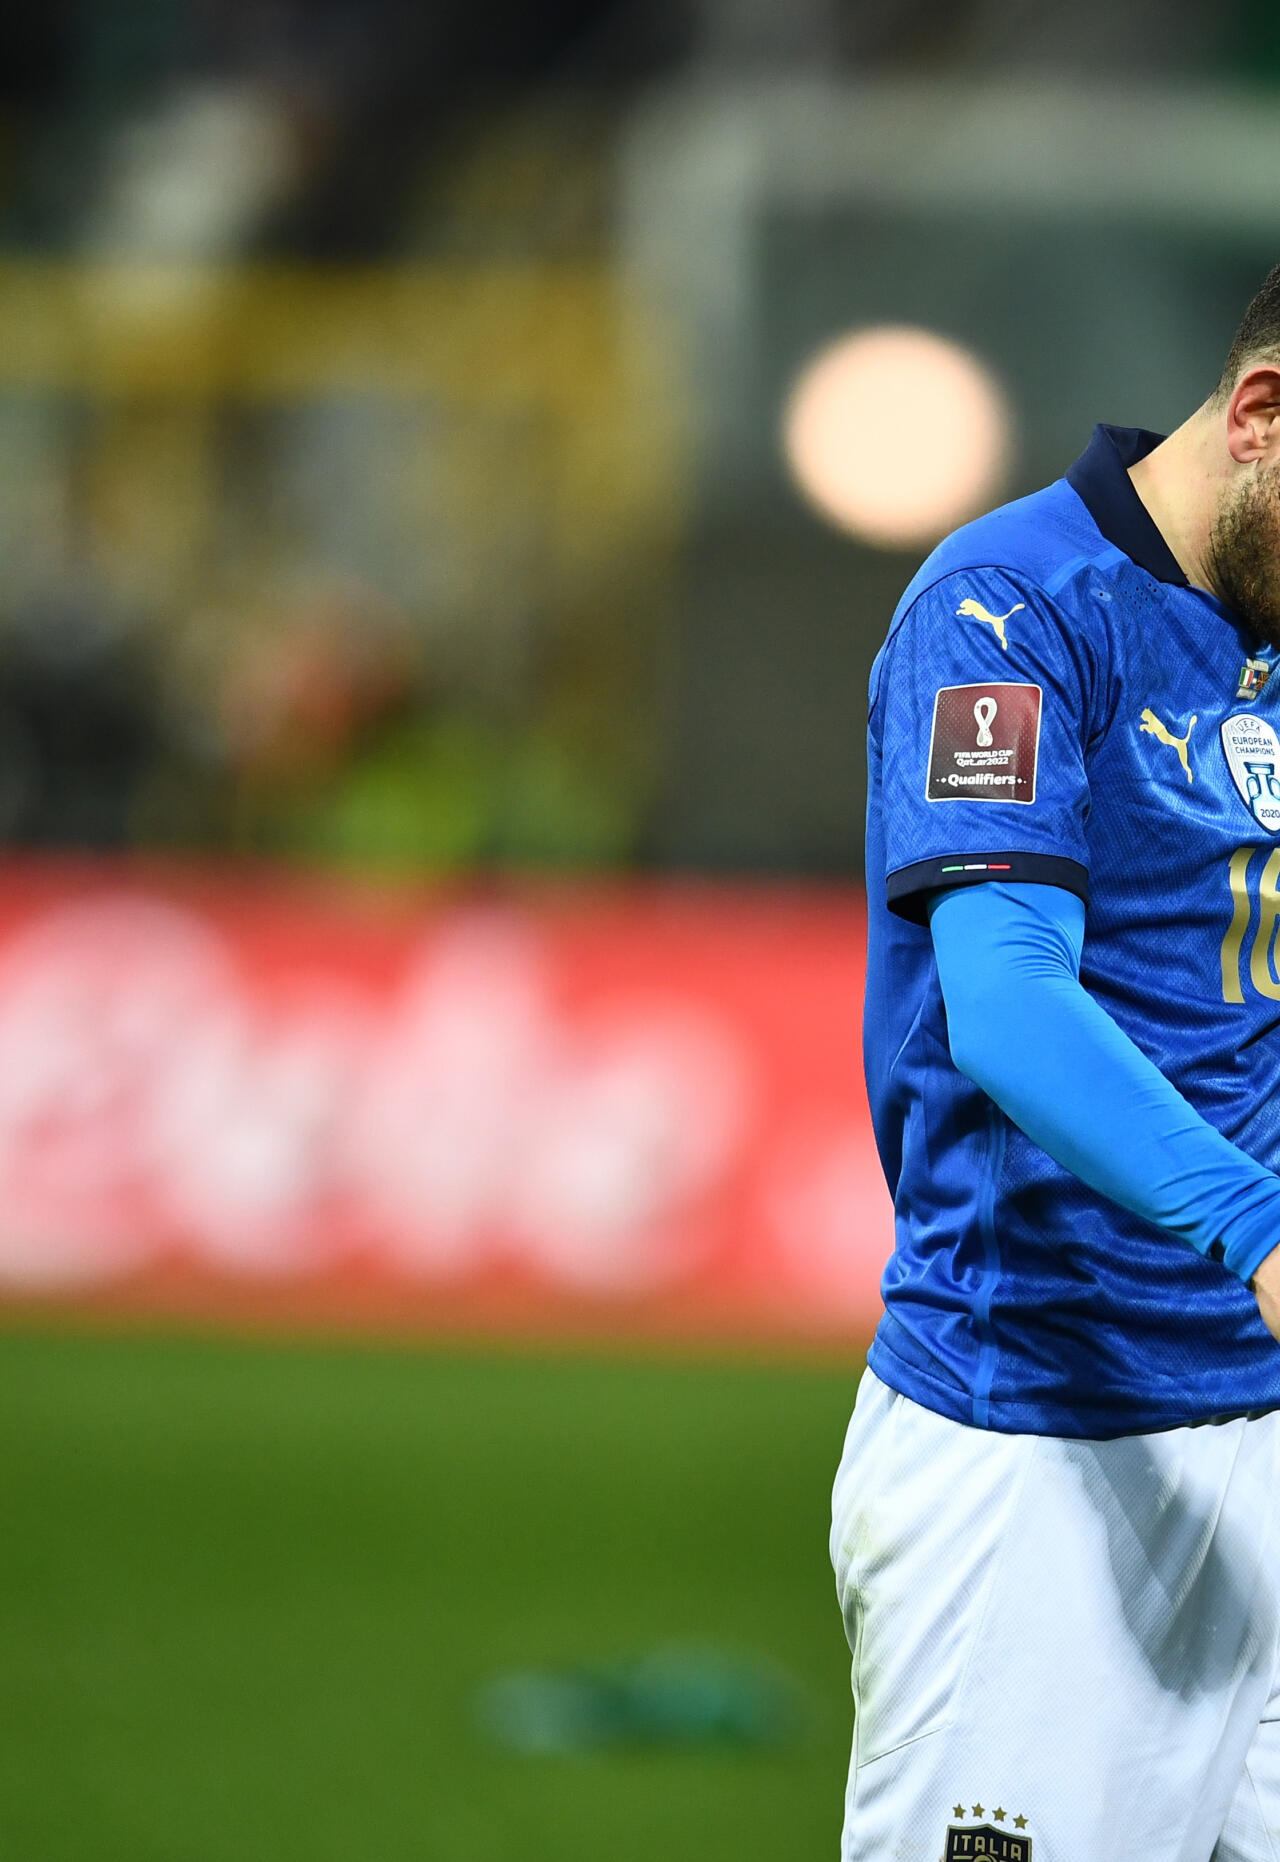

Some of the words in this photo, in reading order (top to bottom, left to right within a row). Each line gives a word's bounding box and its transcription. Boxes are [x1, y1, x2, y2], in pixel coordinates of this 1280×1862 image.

[1232, 737, 1273, 746] EUROPEAN
[954, 751, 971, 759] FIFA
[971, 750, 998, 758] WORLD
[998, 749, 1013, 757] CUP
[1235, 746, 1276, 756] CHAMPIONS
[947, 773, 1016, 787] Qualifiers
[1260, 808, 1280, 819] 2020
[953, 1834, 1022, 1861] ITALIA
